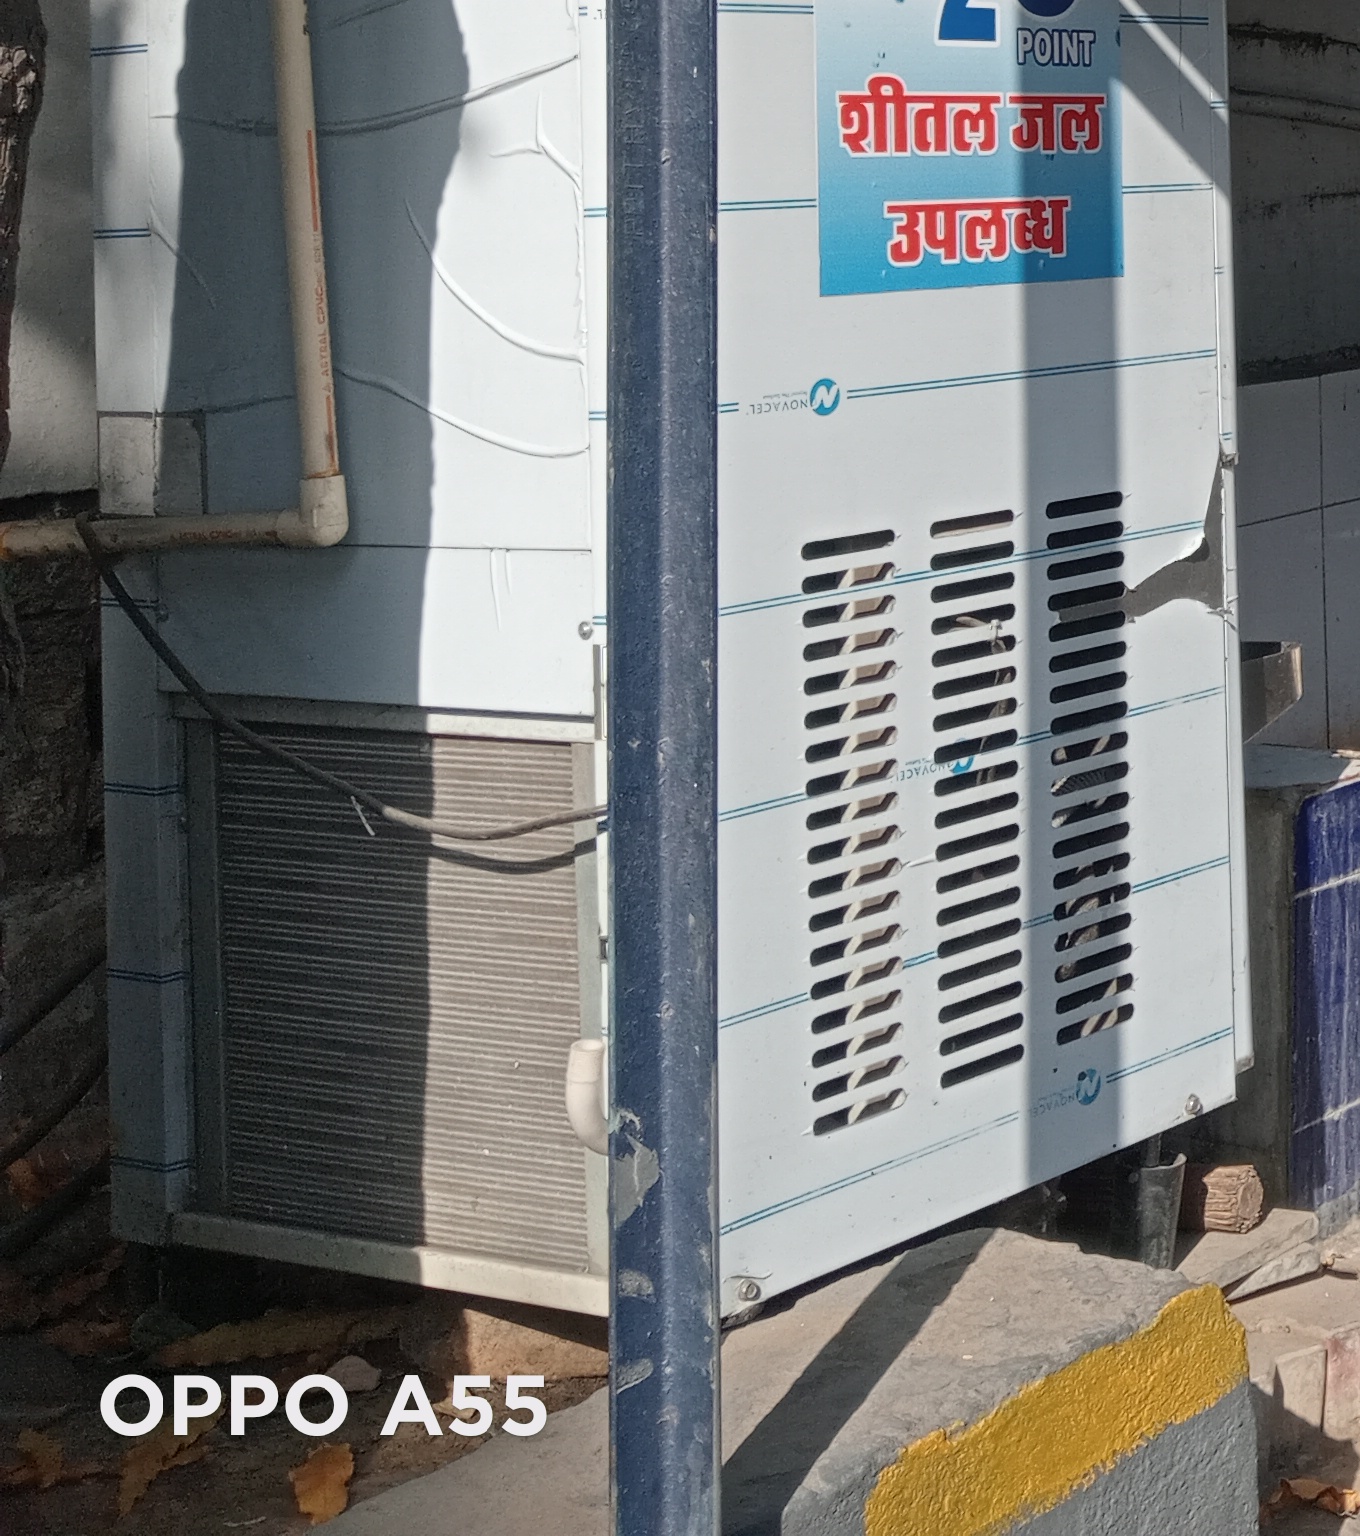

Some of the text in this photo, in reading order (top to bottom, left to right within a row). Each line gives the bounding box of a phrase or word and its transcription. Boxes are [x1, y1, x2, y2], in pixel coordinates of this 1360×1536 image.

[1016, 27, 1096, 67] POINT
[837, 75, 1106, 157] शीतल जल
[884, 196, 1071, 265] उपलब्ध
[749, 399, 808, 415] NOVACEL
